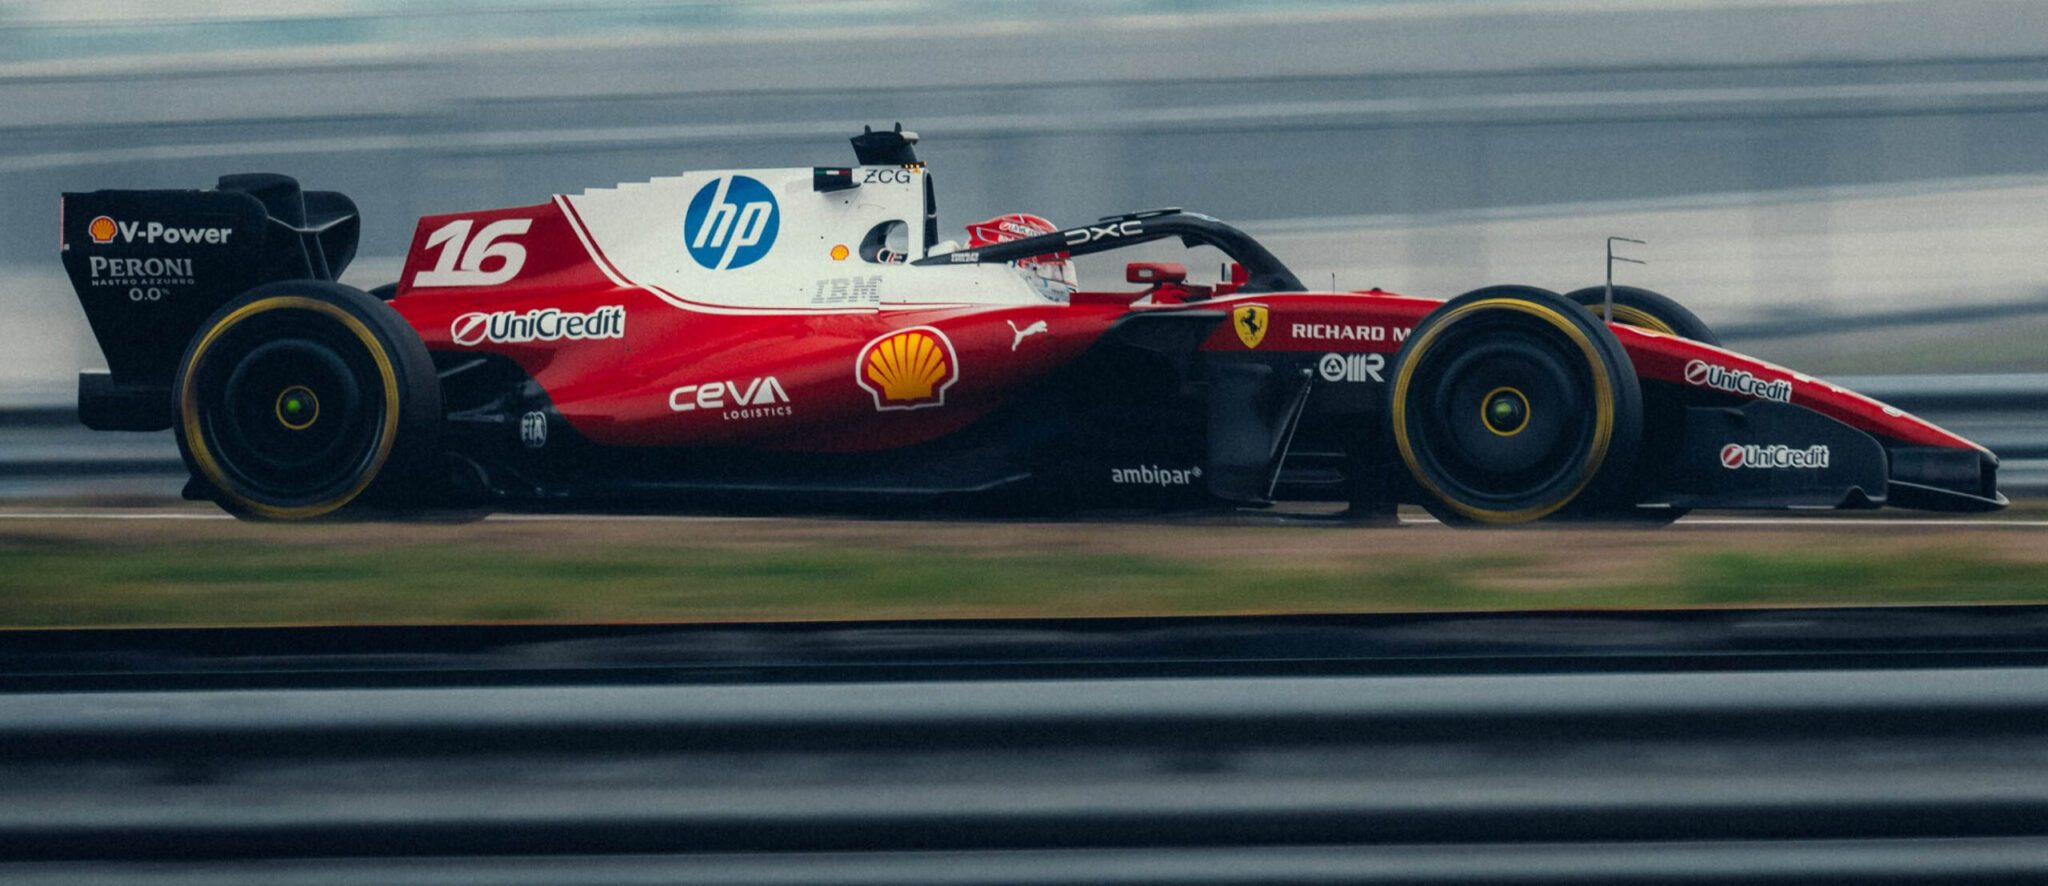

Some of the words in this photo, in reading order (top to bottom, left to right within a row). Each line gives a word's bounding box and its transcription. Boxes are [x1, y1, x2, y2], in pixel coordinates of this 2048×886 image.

[863, 169, 911, 184] ZCG
[118, 221, 233, 244] V-Power
[692, 175, 773, 270] hp
[412, 218, 533, 287] 16
[89, 256, 193, 278] PERONI
[811, 275, 883, 303] IBM
[490, 308, 622, 340] UniCredit
[1292, 323, 1385, 341] RICHARD
[1708, 366, 1790, 401] UniCredit
[723, 406, 792, 420] LOGISTICS
[1744, 446, 1828, 467] UniCredit
